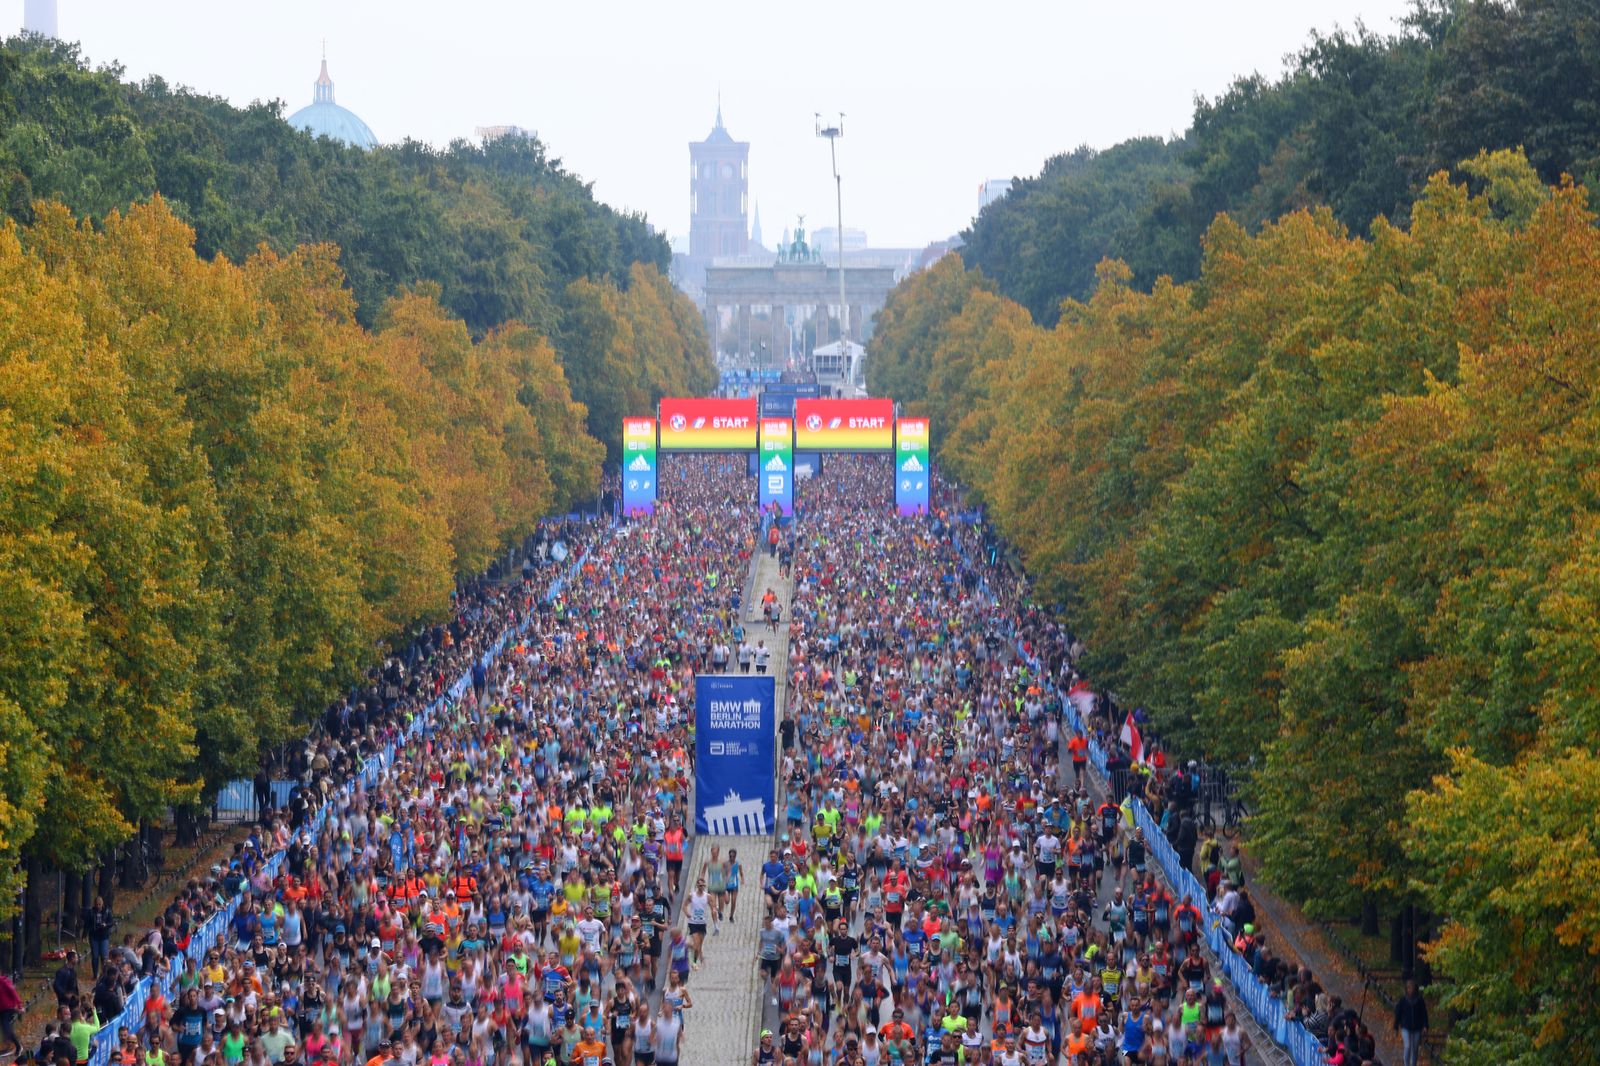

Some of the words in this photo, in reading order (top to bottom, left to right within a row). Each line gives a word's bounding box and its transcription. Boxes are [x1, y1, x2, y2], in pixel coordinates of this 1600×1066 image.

[713, 416, 749, 428] START
[849, 416, 885, 428] START
[711, 701, 741, 712] BMW
[711, 721, 760, 729] MARATHON
